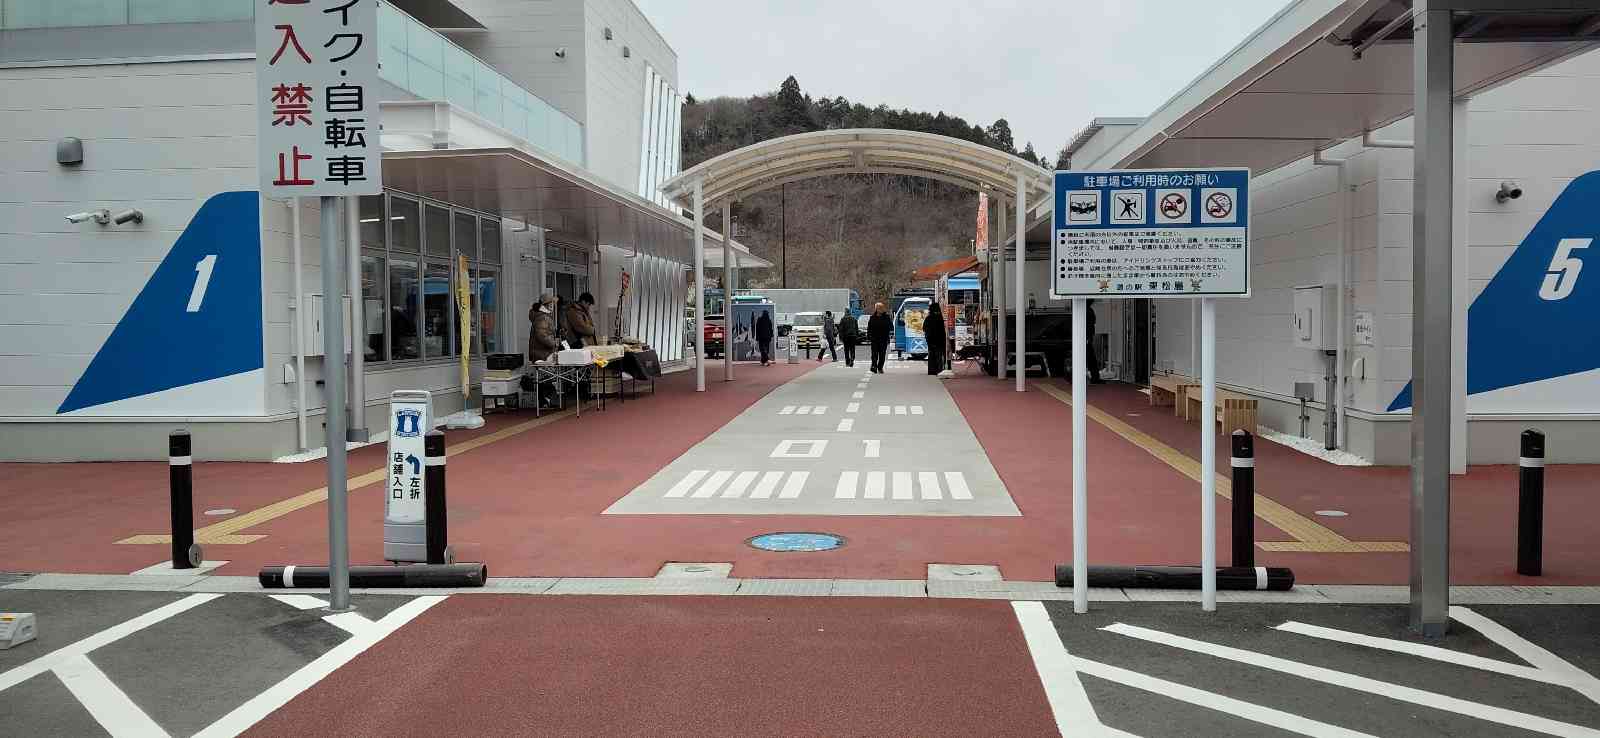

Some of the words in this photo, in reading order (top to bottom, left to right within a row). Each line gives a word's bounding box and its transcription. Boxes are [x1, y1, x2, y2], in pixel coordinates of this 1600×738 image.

[268, 0, 315, 187] 入禁止
[1083, 173, 1219, 188] 駐車場ご利用時のお願い
[186, 254, 218, 313] 1
[1537, 238, 1593, 301] 5
[393, 452, 404, 500] 店舗入口
[409, 477, 421, 500] 左折
